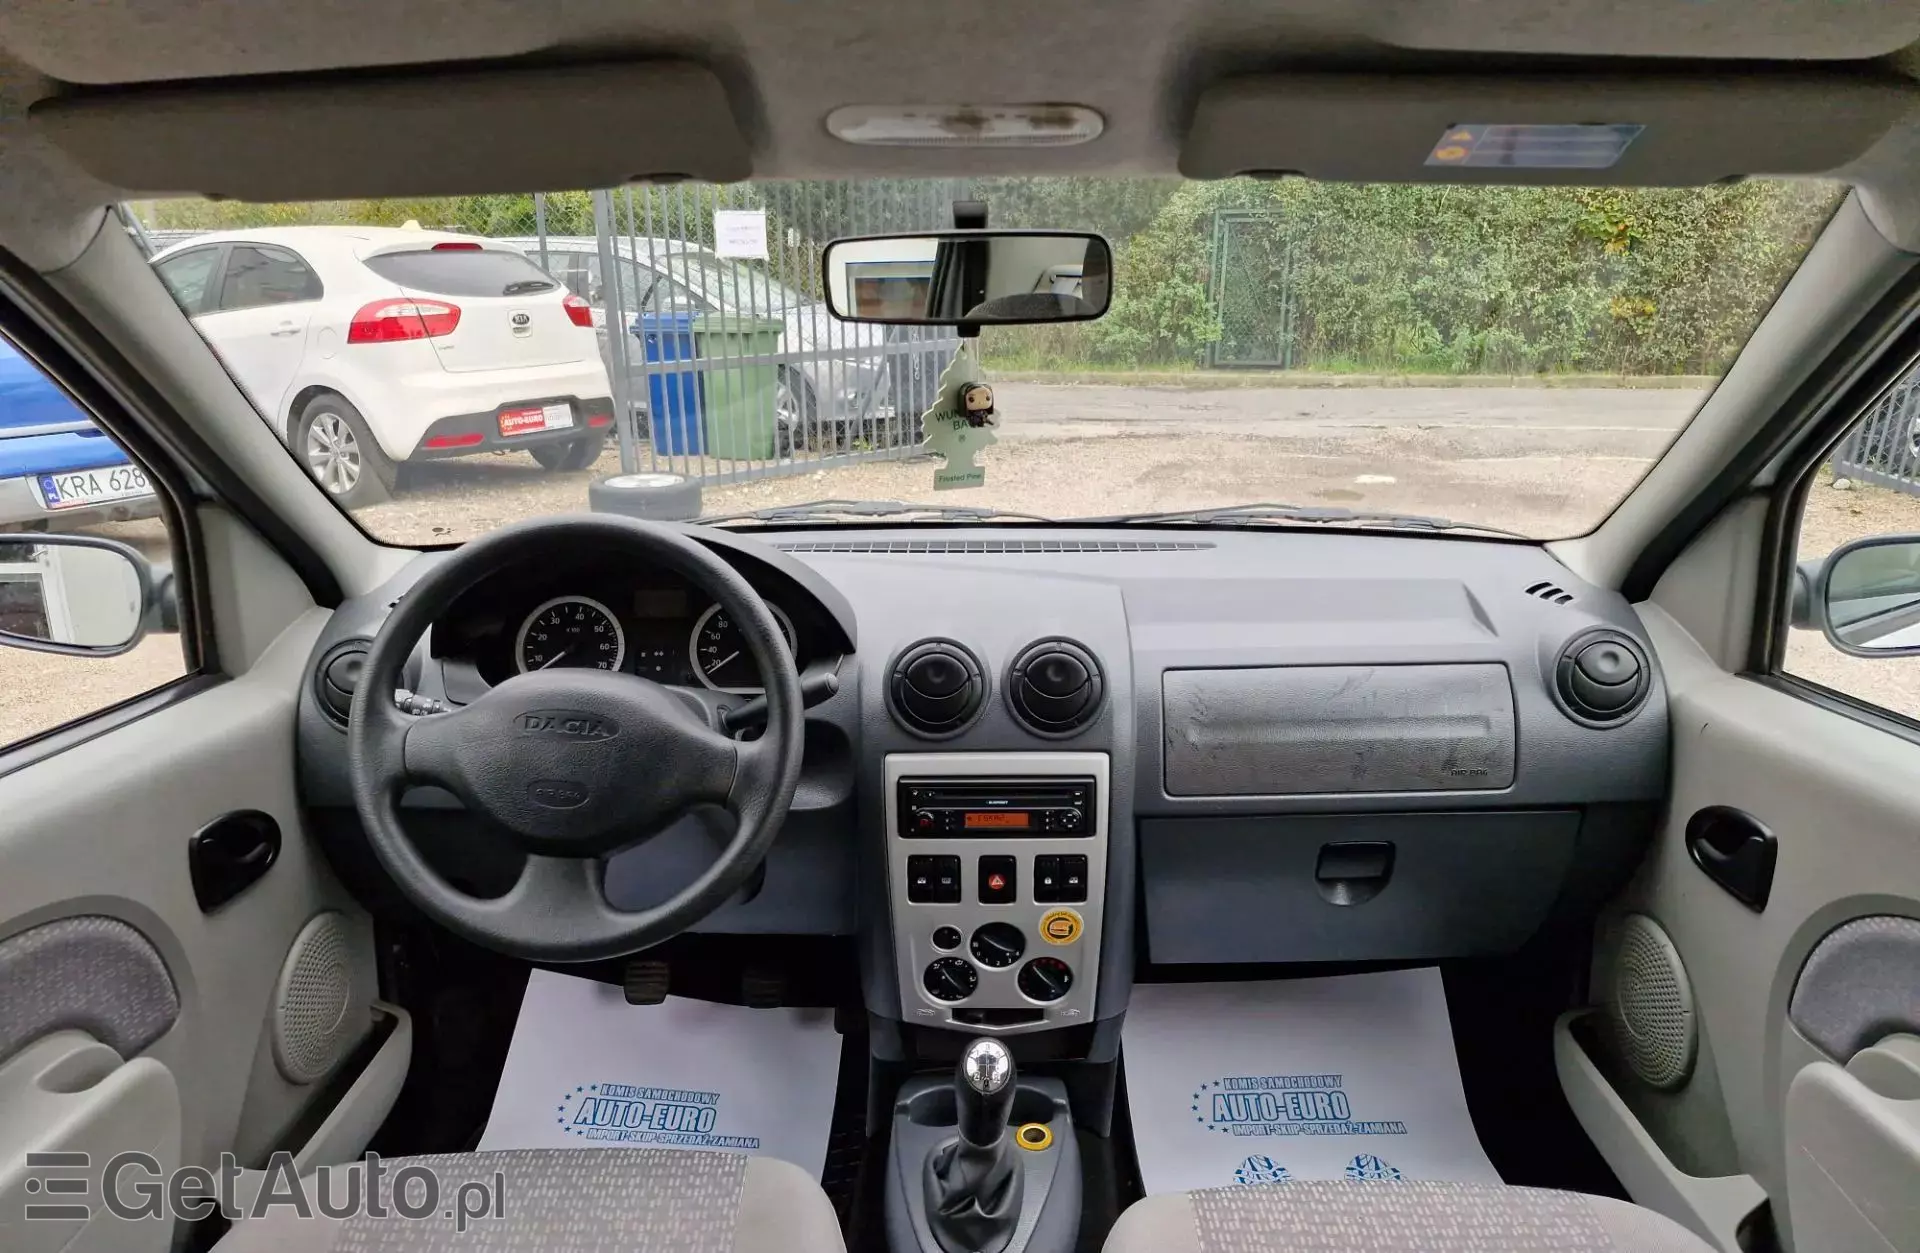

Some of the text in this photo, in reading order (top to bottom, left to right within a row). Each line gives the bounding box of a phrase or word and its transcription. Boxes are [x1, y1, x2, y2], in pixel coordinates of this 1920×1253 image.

[504, 414, 543, 426] AUTO-EURO
[56, 467, 146, 500] KRA 628
[938, 473, 965, 483] Frosted
[575, 612, 585, 620] 40
[594, 625, 604, 633] 50
[718, 620, 728, 628] 80
[598, 661, 607, 669] 70
[712, 659, 721, 667] 20
[524, 715, 610, 736] DACIA
[1223, 1075, 1342, 1090] KOMIS SAMOCHODOWY
[601, 1083, 720, 1105] KOMIS SAMOCHODOWY
[1213, 1091, 1351, 1122] AUTO-EURO
[574, 1097, 717, 1133] AUTO-EURO
